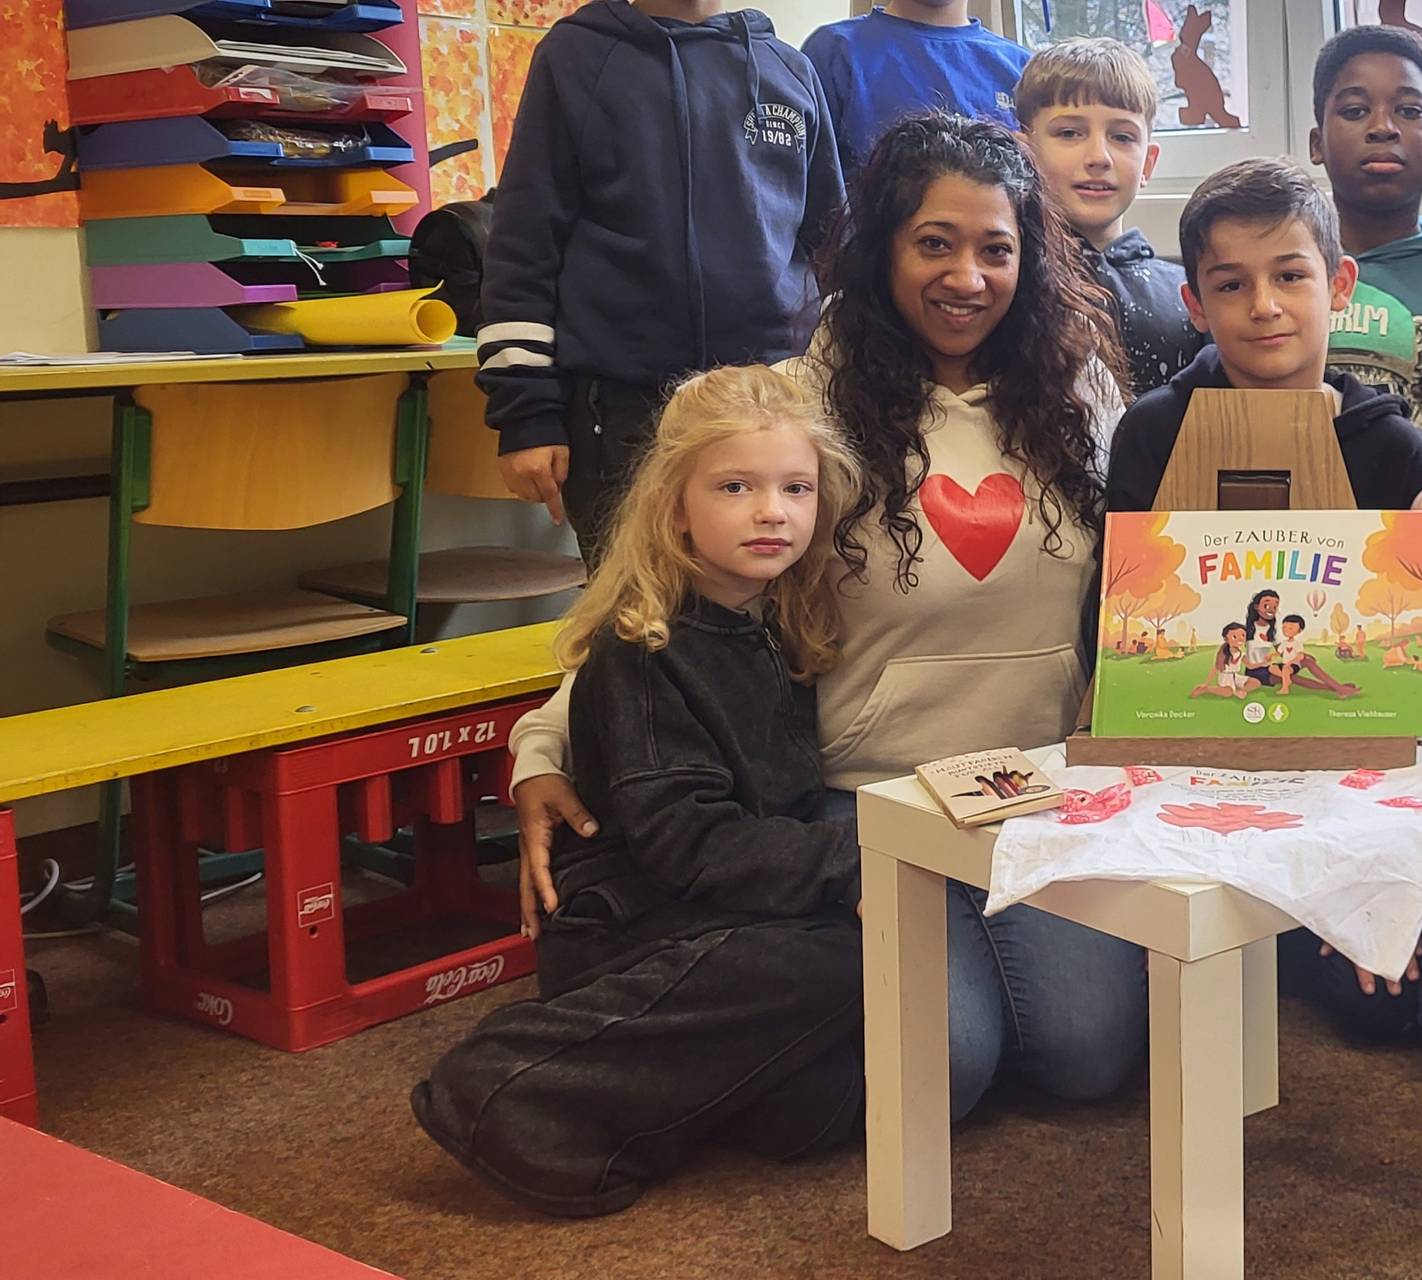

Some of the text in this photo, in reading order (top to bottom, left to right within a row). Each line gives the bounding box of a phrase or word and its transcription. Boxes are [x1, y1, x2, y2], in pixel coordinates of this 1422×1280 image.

[1203, 529, 1345, 549] Der ZAUBER von
[1198, 549, 1348, 587] FAMILIE
[457, 726, 472, 743] x
[474, 720, 497, 744] 12
[422, 954, 505, 1006] Coca-Cola
[197, 991, 233, 1026] Coke
